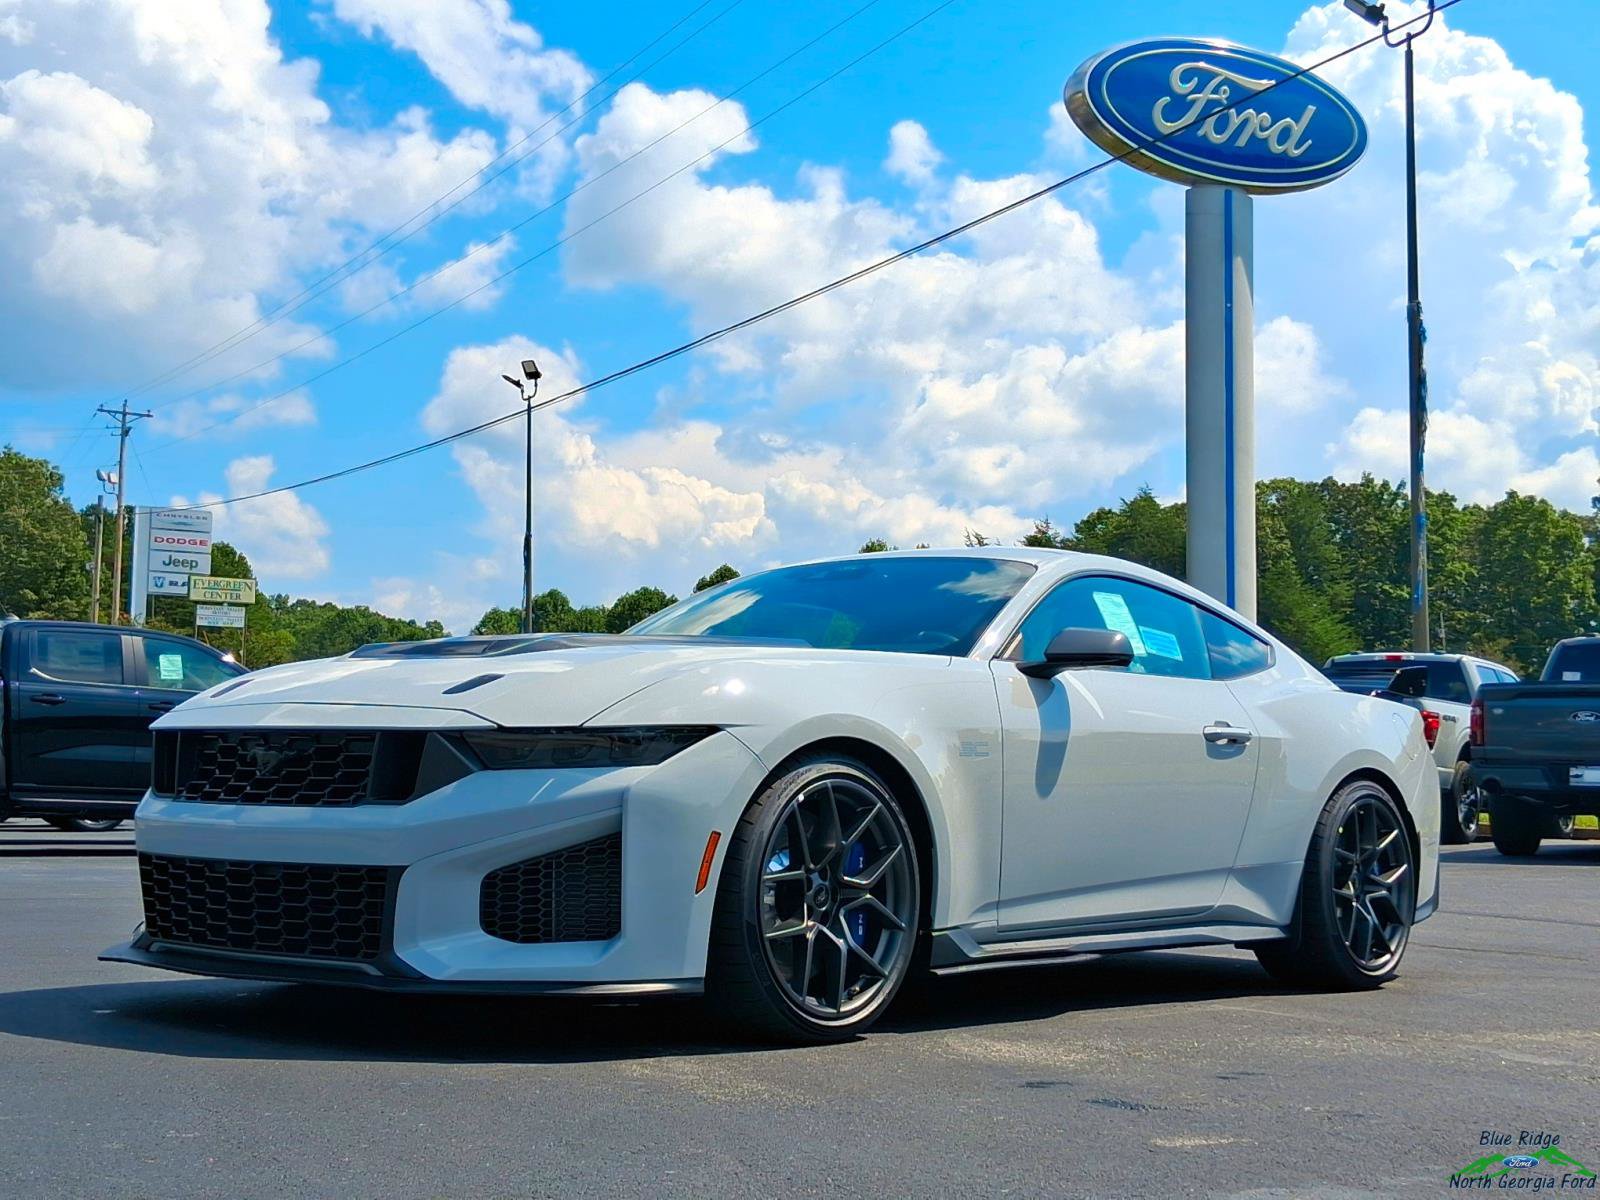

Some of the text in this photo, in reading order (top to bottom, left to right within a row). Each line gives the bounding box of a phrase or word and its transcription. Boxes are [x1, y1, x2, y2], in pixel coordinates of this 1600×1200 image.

[1152, 61, 1317, 158] Ford
[154, 536, 208, 547] DODGE
[162, 554, 198, 570] Jeep
[193, 579, 253, 591] EVERGREEN
[204, 591, 241, 600] CENTER
